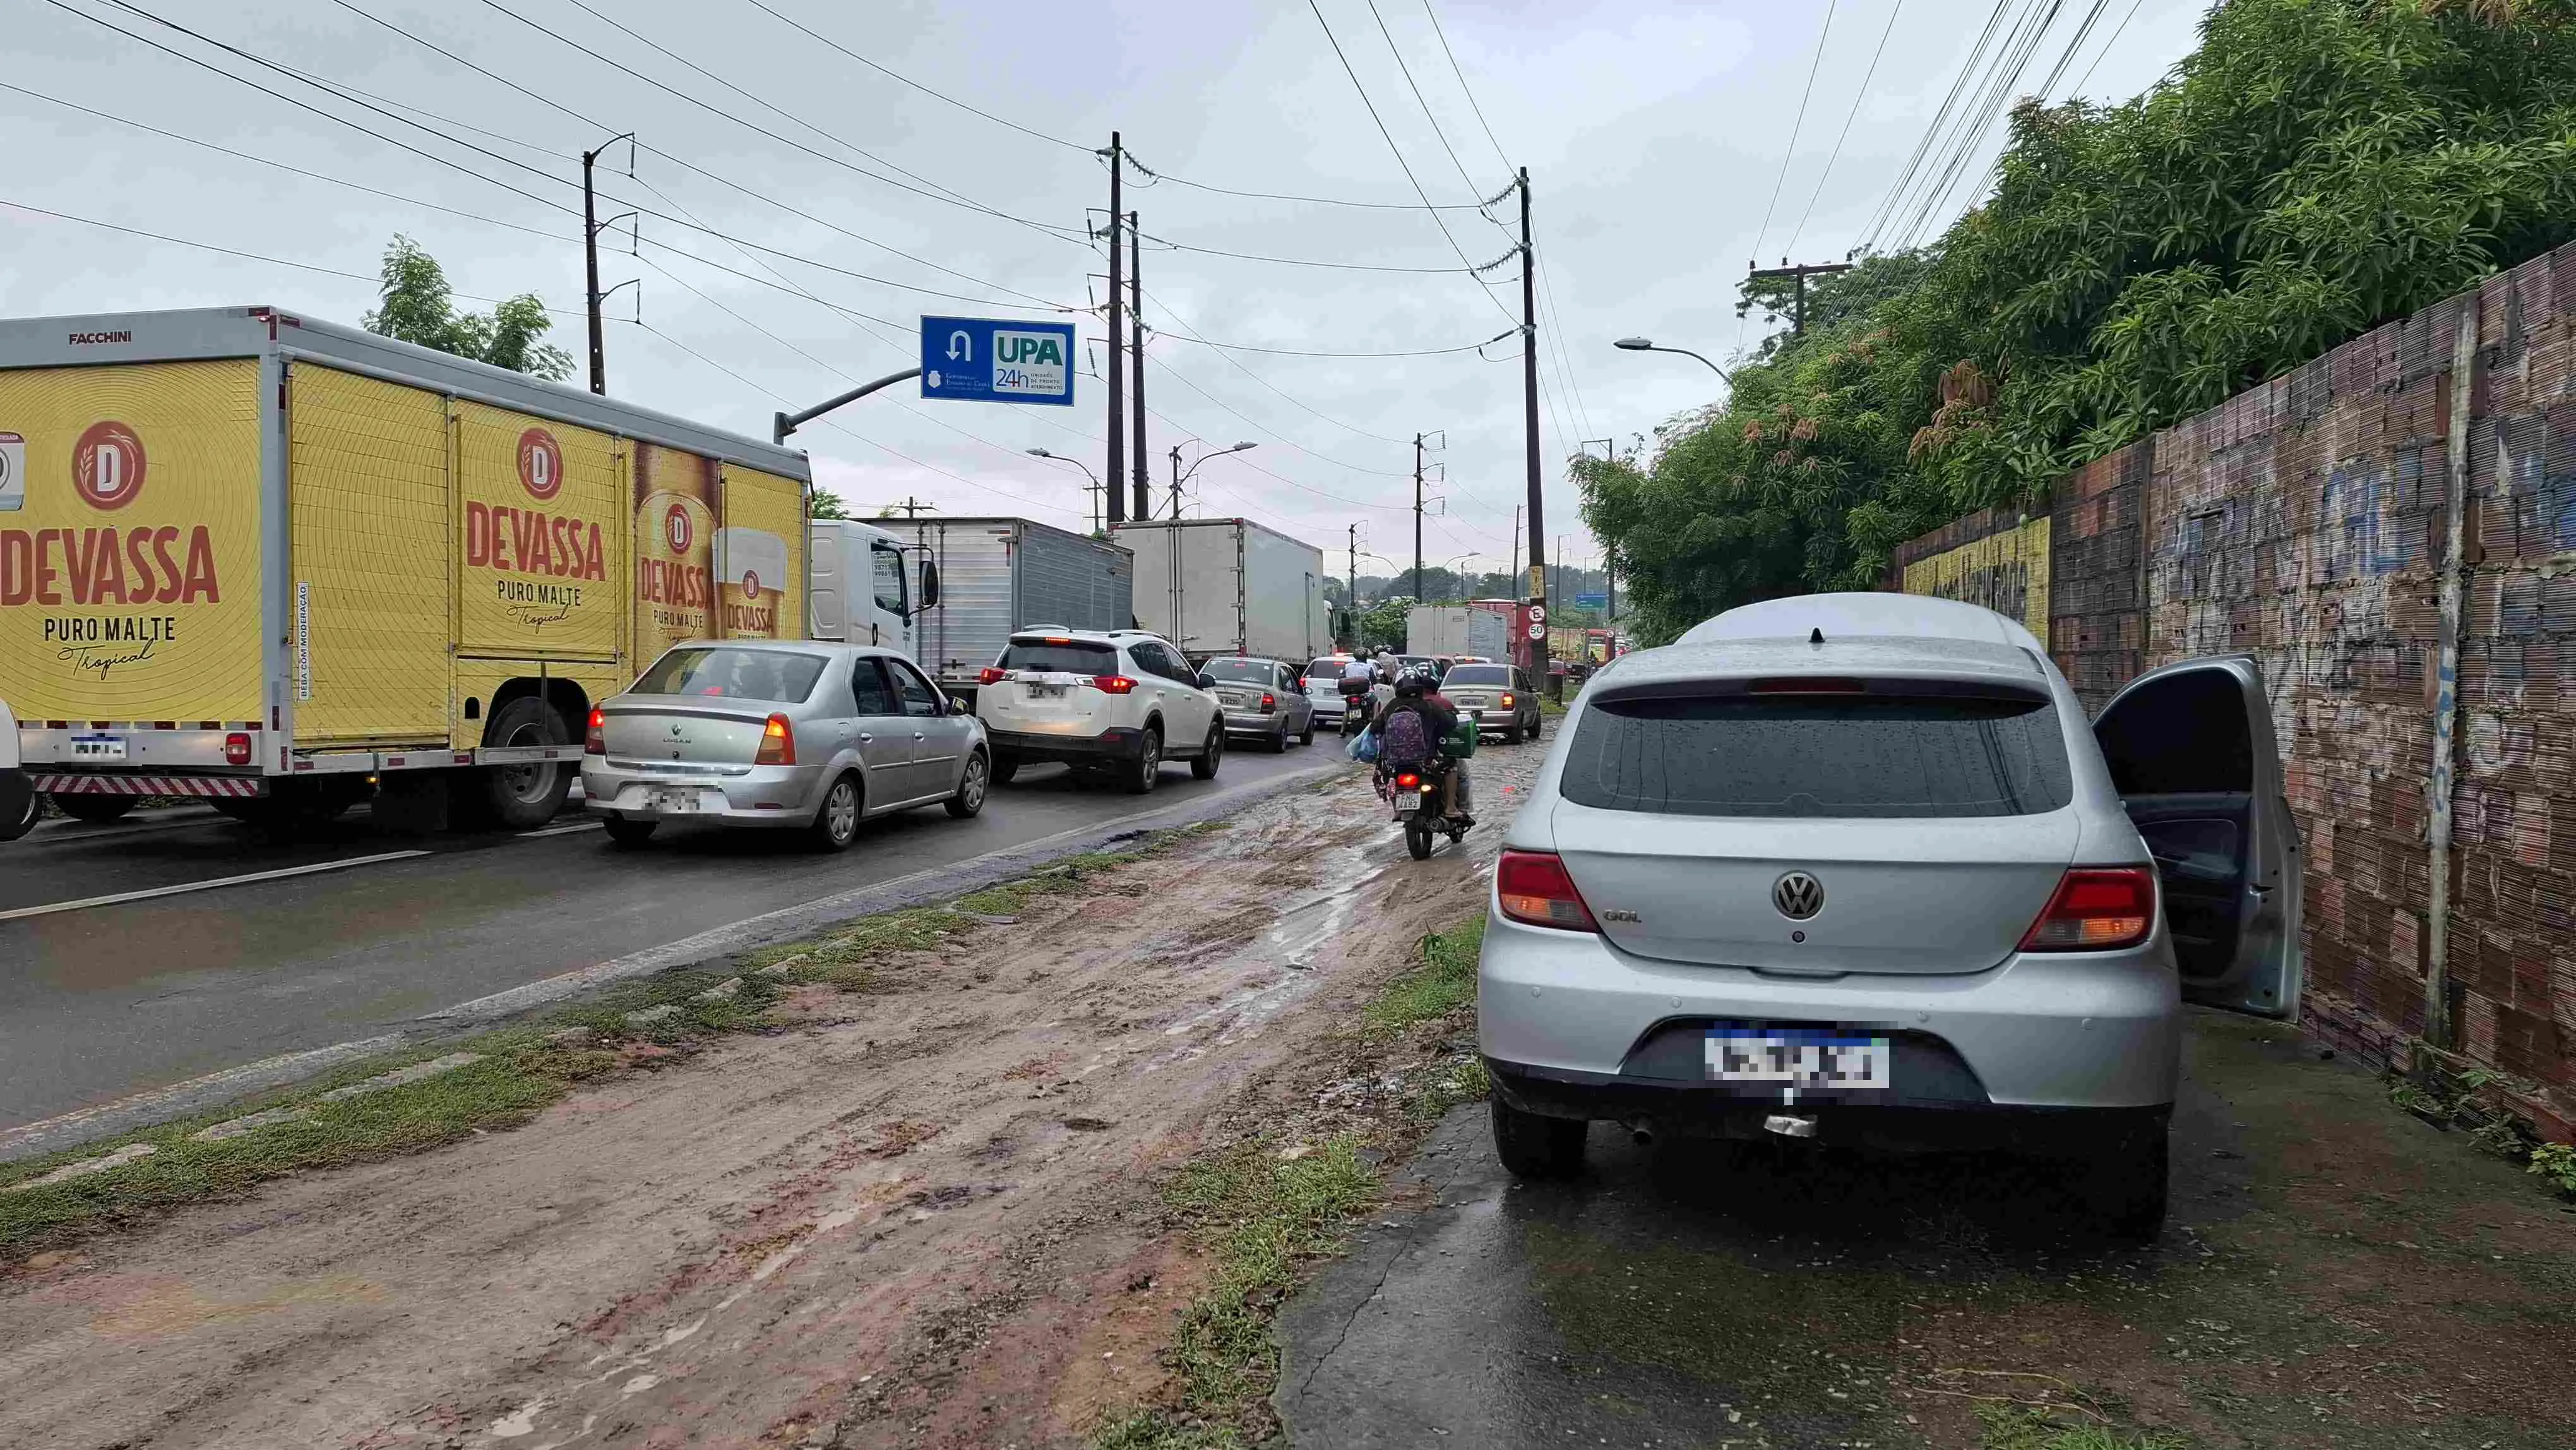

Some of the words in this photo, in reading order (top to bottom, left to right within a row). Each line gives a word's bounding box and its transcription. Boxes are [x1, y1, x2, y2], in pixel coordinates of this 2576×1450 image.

[69, 331, 131, 345] FACCHINI
[998, 337, 1063, 366] UPA
[996, 368, 1029, 388] 24h
[97, 445, 121, 491] D
[532, 445, 548, 484] D
[467, 501, 606, 581] DEVASSA
[1, 525, 220, 606] DEVASSA
[498, 580, 533, 601] PURO
[539, 585, 580, 606] MALTE
[45, 618, 97, 641] PURO
[105, 616, 175, 640] MALTE
[507, 603, 569, 634] Tropical
[653, 610, 674, 625] PURO
[677, 613, 703, 628] MALTE
[727, 604, 773, 632] DEVASSA
[57, 637, 155, 680] Tropical
[1604, 909, 1642, 923] GOL
